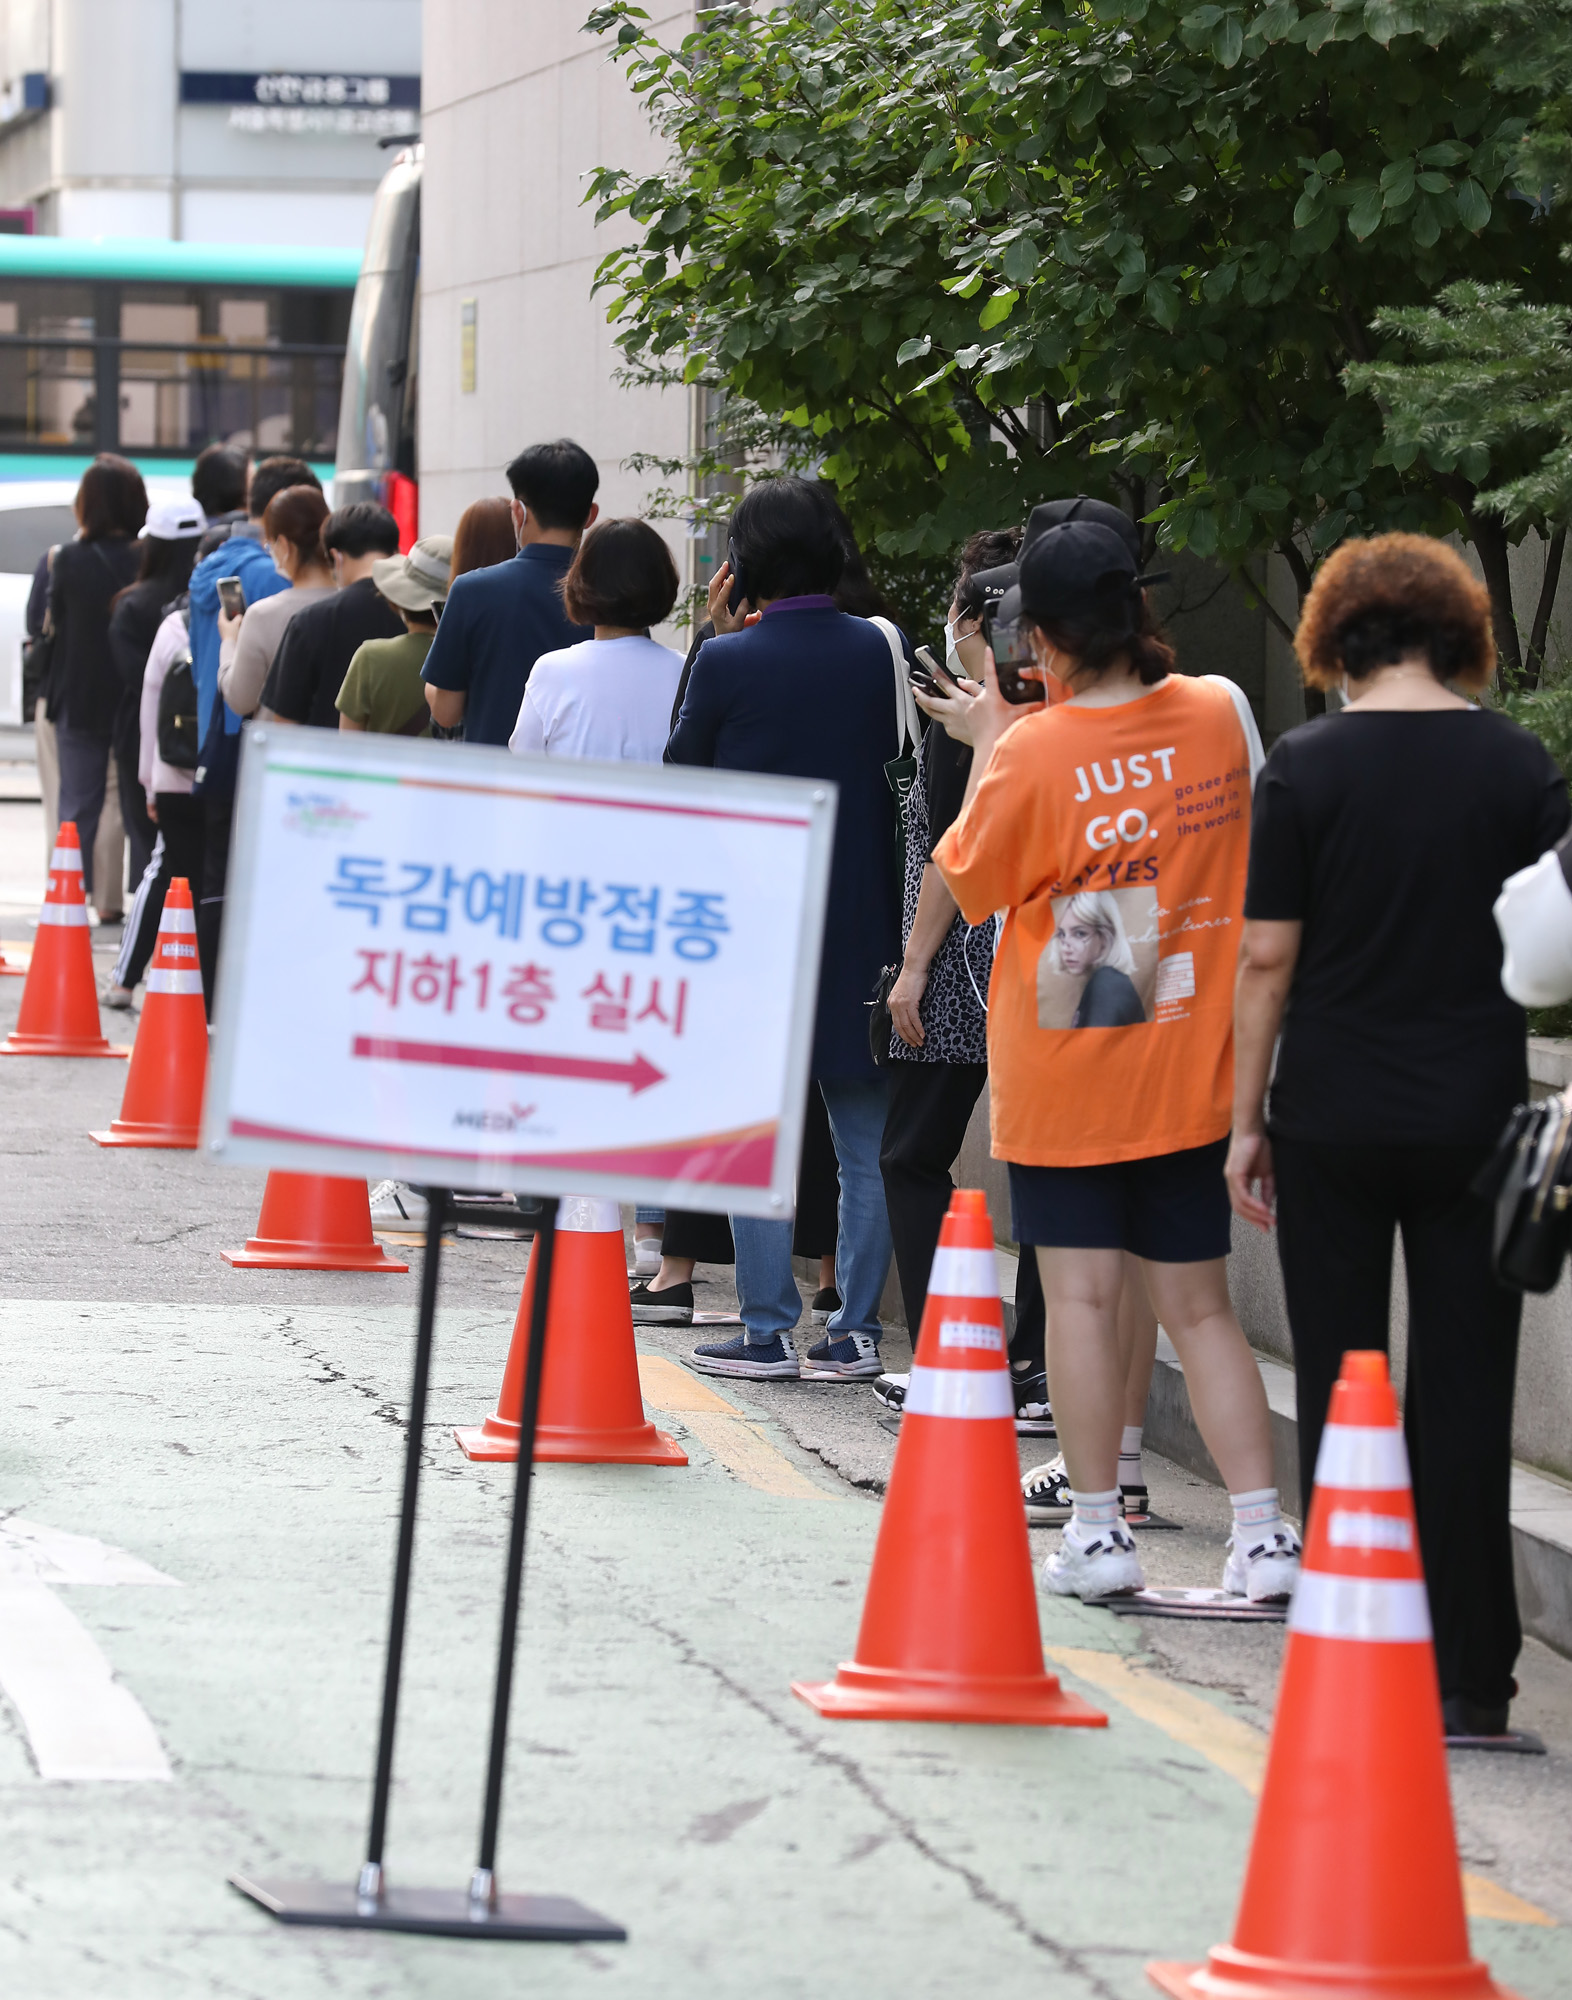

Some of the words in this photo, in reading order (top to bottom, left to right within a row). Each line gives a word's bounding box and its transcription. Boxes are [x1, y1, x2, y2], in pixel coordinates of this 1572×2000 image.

[1074, 747, 1176, 802] JUST
[1174, 786, 1194, 800] go
[1198, 775, 1222, 793] see
[1176, 794, 1225, 817] beauty
[1085, 808, 1159, 851] GO.
[1177, 820, 1201, 837] the
[1107, 856, 1160, 886] YES
[326, 855, 731, 963] 독감예방접종
[350, 948, 556, 1025] 지하1층
[580, 969, 689, 1038] 실시
